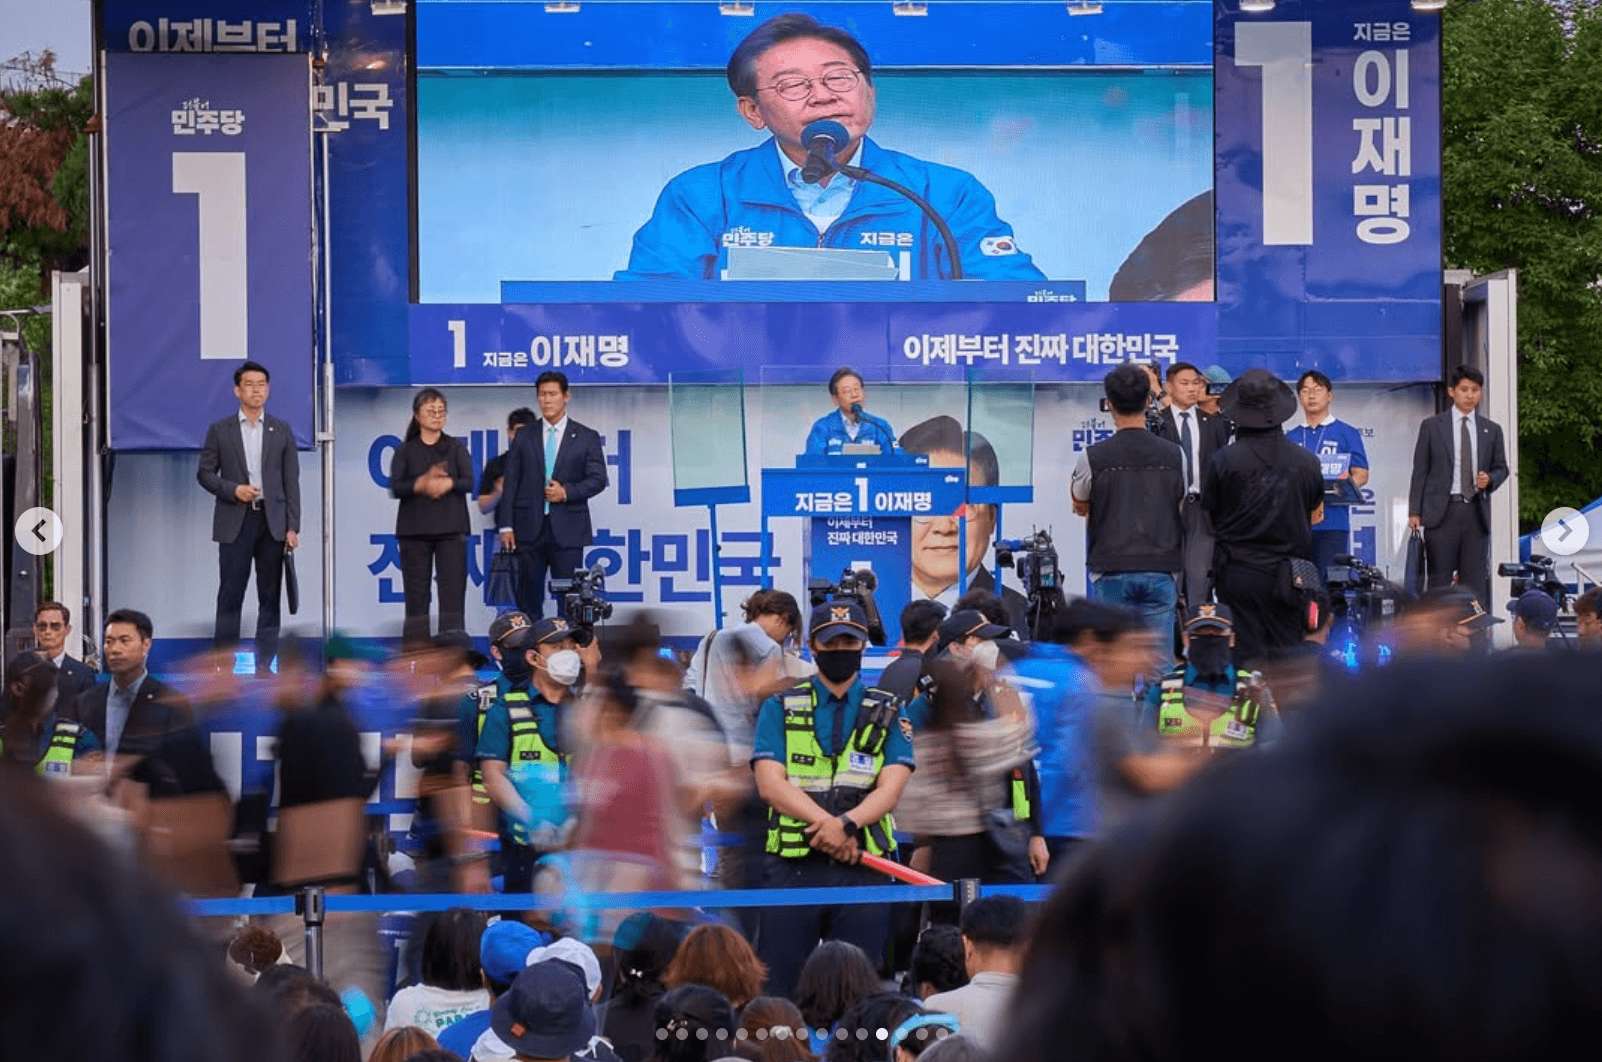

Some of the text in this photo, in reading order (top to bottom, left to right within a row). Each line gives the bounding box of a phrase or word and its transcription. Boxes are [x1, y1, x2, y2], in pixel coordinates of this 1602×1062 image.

[128, 17, 297, 51] 이제부터
[1353, 22, 1411, 41] 지금은
[171, 109, 246, 135] 민주당
[1234, 21, 1314, 245] 1
[1352, 49, 1411, 244] 이재명
[172, 152, 248, 359] 1
[859, 232, 914, 247] 지금은
[448, 320, 629, 368] 1 지금은 이재명
[903, 333, 1179, 365] 이제부터 진짜 대한민국
[795, 477, 931, 512] 지금은 1 이재명
[852, 531, 898, 545] 대한민국
